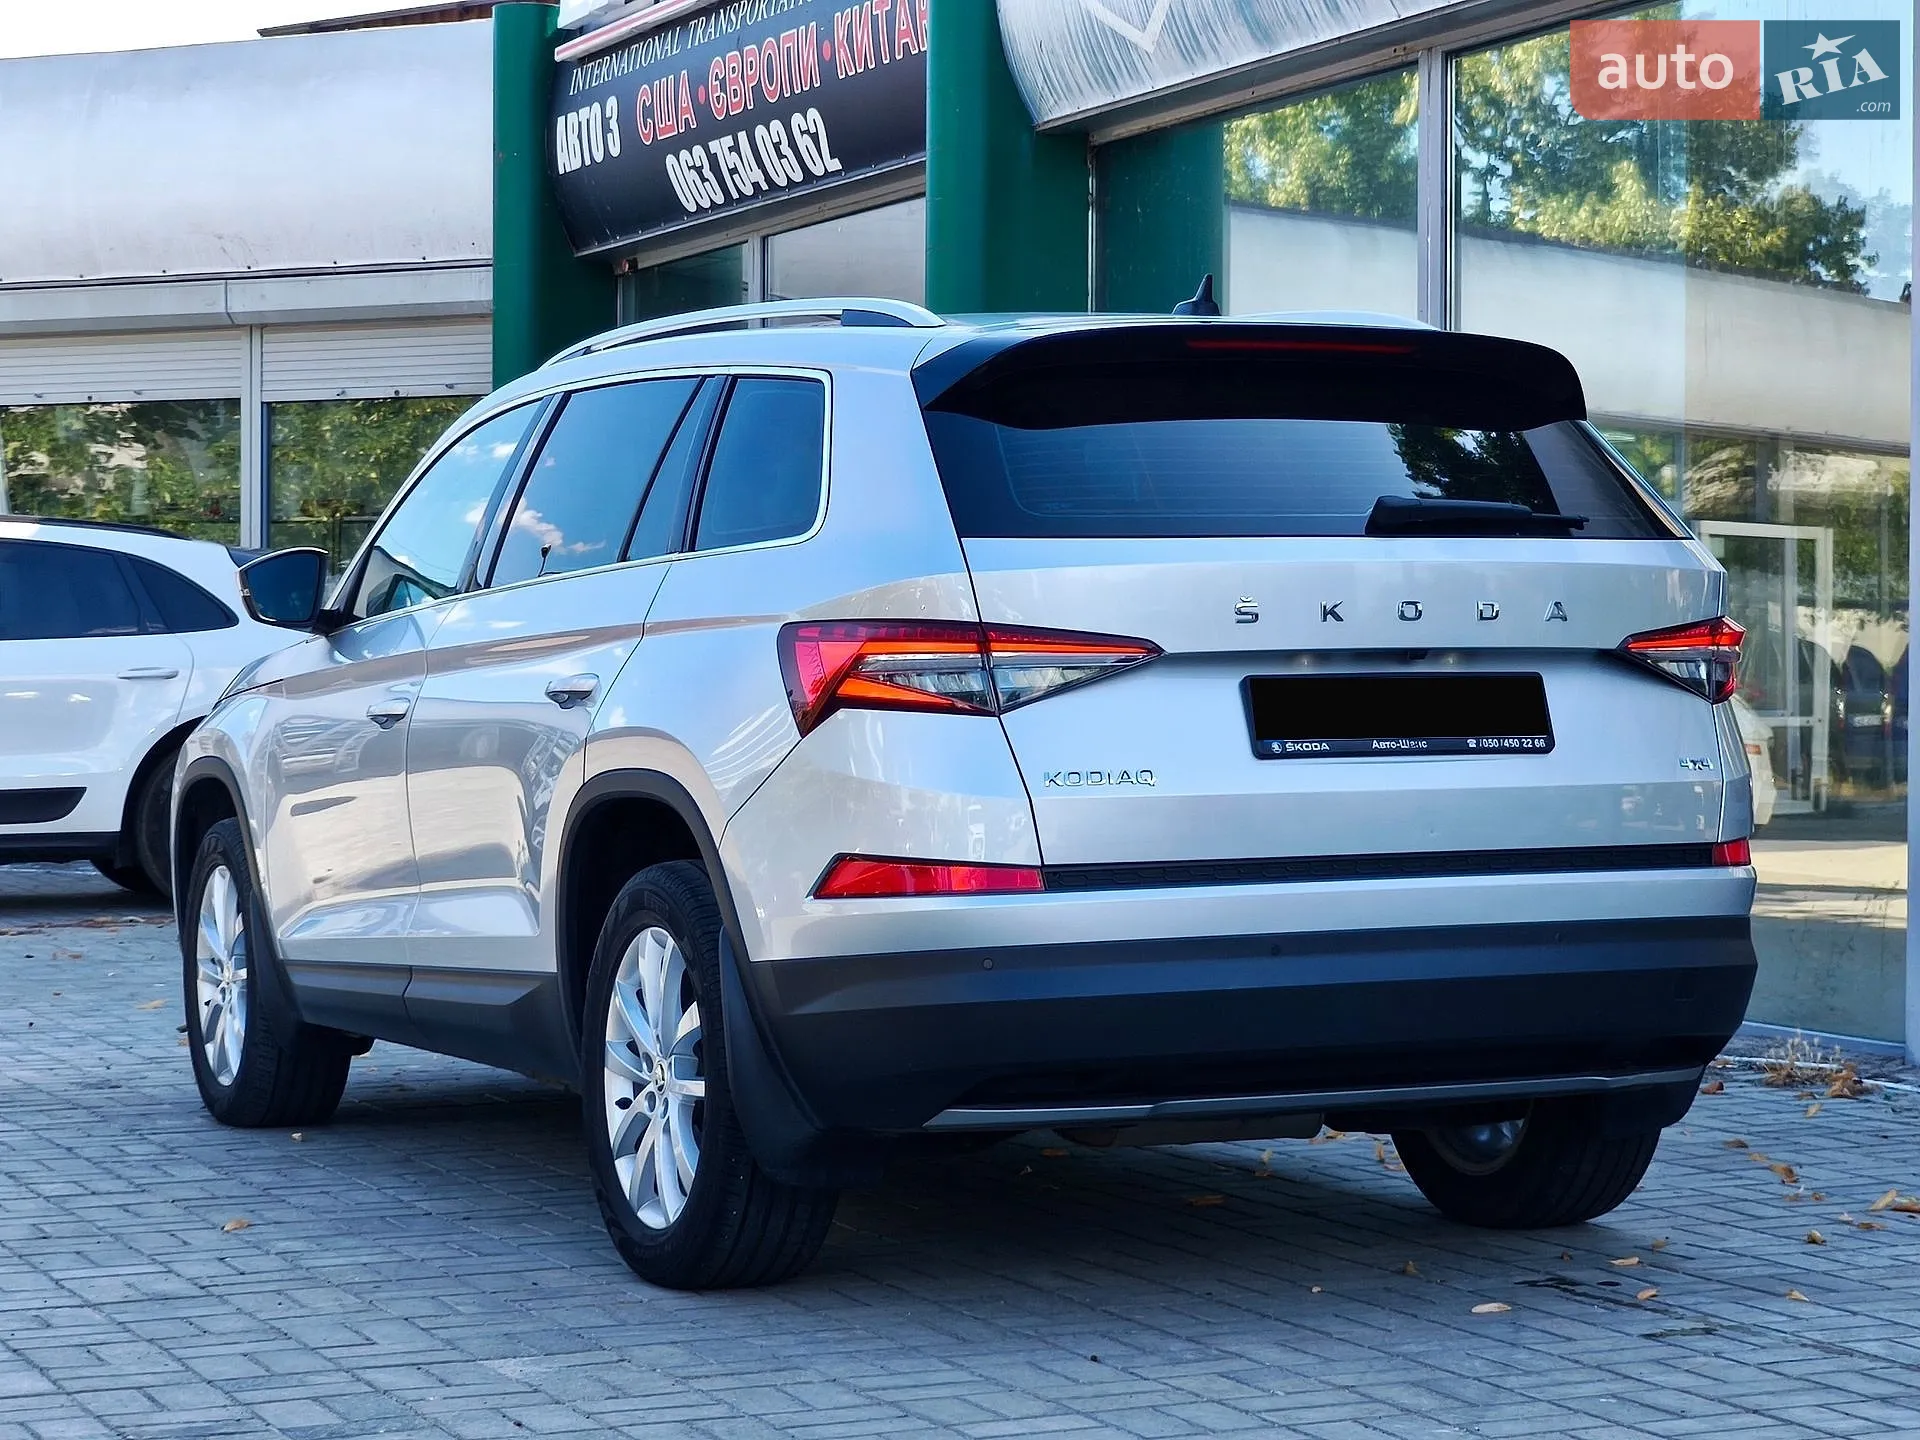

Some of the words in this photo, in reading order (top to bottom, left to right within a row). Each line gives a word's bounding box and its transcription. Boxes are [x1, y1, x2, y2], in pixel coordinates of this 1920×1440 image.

[569, 26, 682, 96] INTERNATIONAL
[557, 101, 604, 175] АВТО
[636, 69, 698, 146] США
[708, 20, 821, 121] ЄВРОПИ
[665, 144, 725, 213] 063
[708, 130, 769, 200] 754
[754, 119, 804, 187] 03
[790, 107, 843, 177] 62
[1234, 595, 1569, 624] ŠKODA
[1521, 738, 1533, 748] 22
[1043, 769, 1156, 787] KODIAQ
